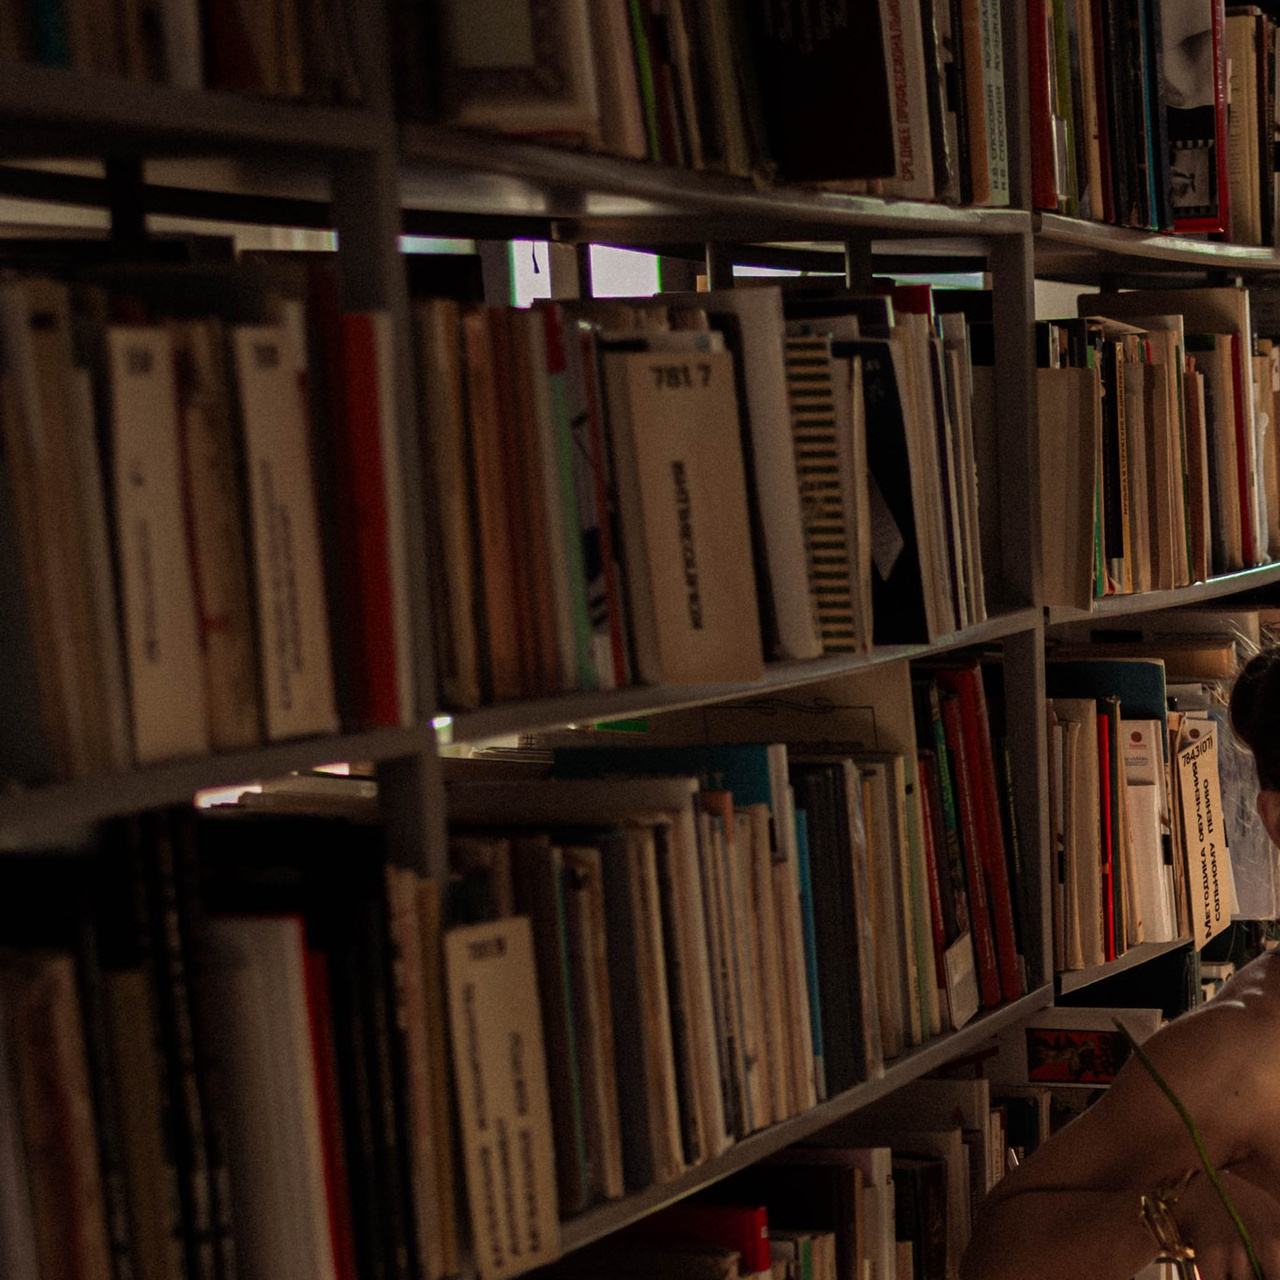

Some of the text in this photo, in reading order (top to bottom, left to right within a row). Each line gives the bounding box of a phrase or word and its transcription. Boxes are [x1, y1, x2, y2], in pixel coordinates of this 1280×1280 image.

[1192, 761, 1212, 939] МЕТОДИКА ОБУЧЕНИЯ
[1203, 779, 1221, 922] СОЛЬНОМУ ПЕНИЮ
